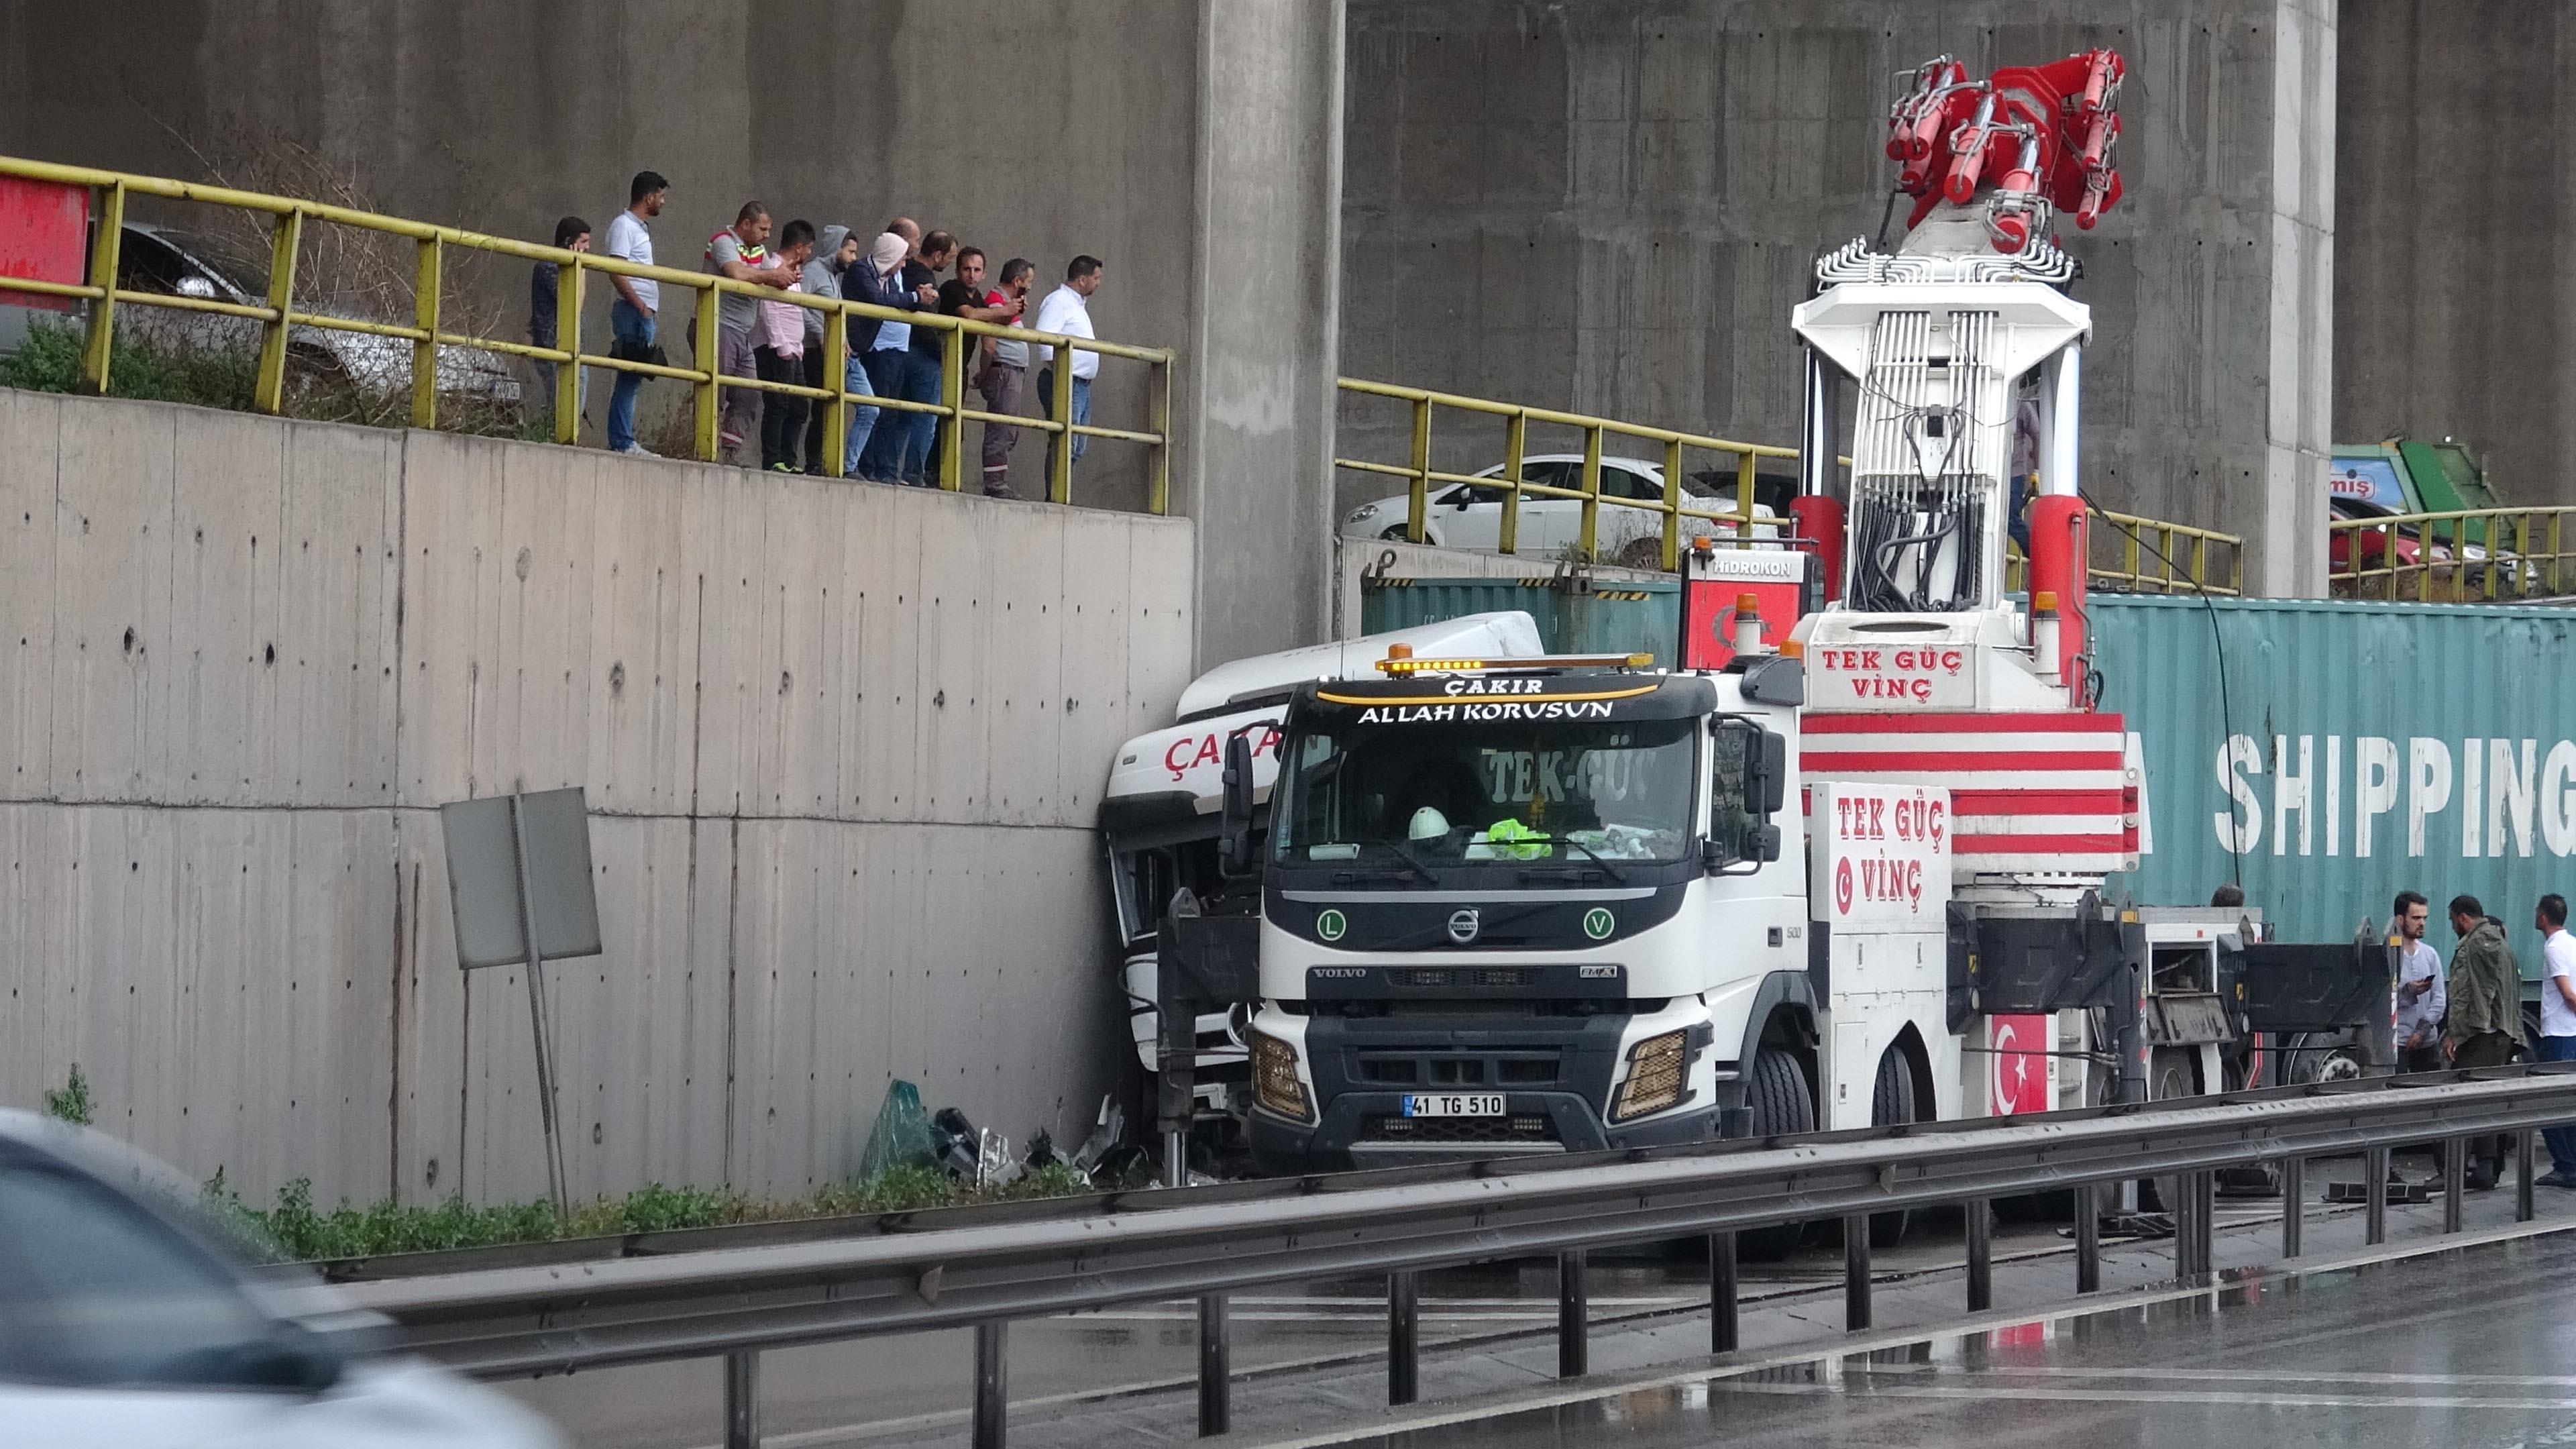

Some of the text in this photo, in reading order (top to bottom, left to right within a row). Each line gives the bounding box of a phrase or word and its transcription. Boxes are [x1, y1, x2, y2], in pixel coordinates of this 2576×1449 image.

[1822, 643, 1962, 676] TEK GÜÇ
[1444, 680, 1544, 697] ÇAKIR
[1851, 673, 1932, 704] VİNÇ
[1357, 702, 1613, 724] ALLAH KORUSUN
[2214, 733, 2576, 858] SHIPPING
[1838, 788, 1944, 854] TEK GÜÇ
[1860, 848, 1923, 913] VİNÇ
[1326, 916, 1338, 934] L
[1592, 915, 1606, 932] V
[1786, 927, 1802, 938] 500
[1313, 968, 1366, 978] VOLVO
[1413, 1097, 1501, 1114] 41 TG 510
